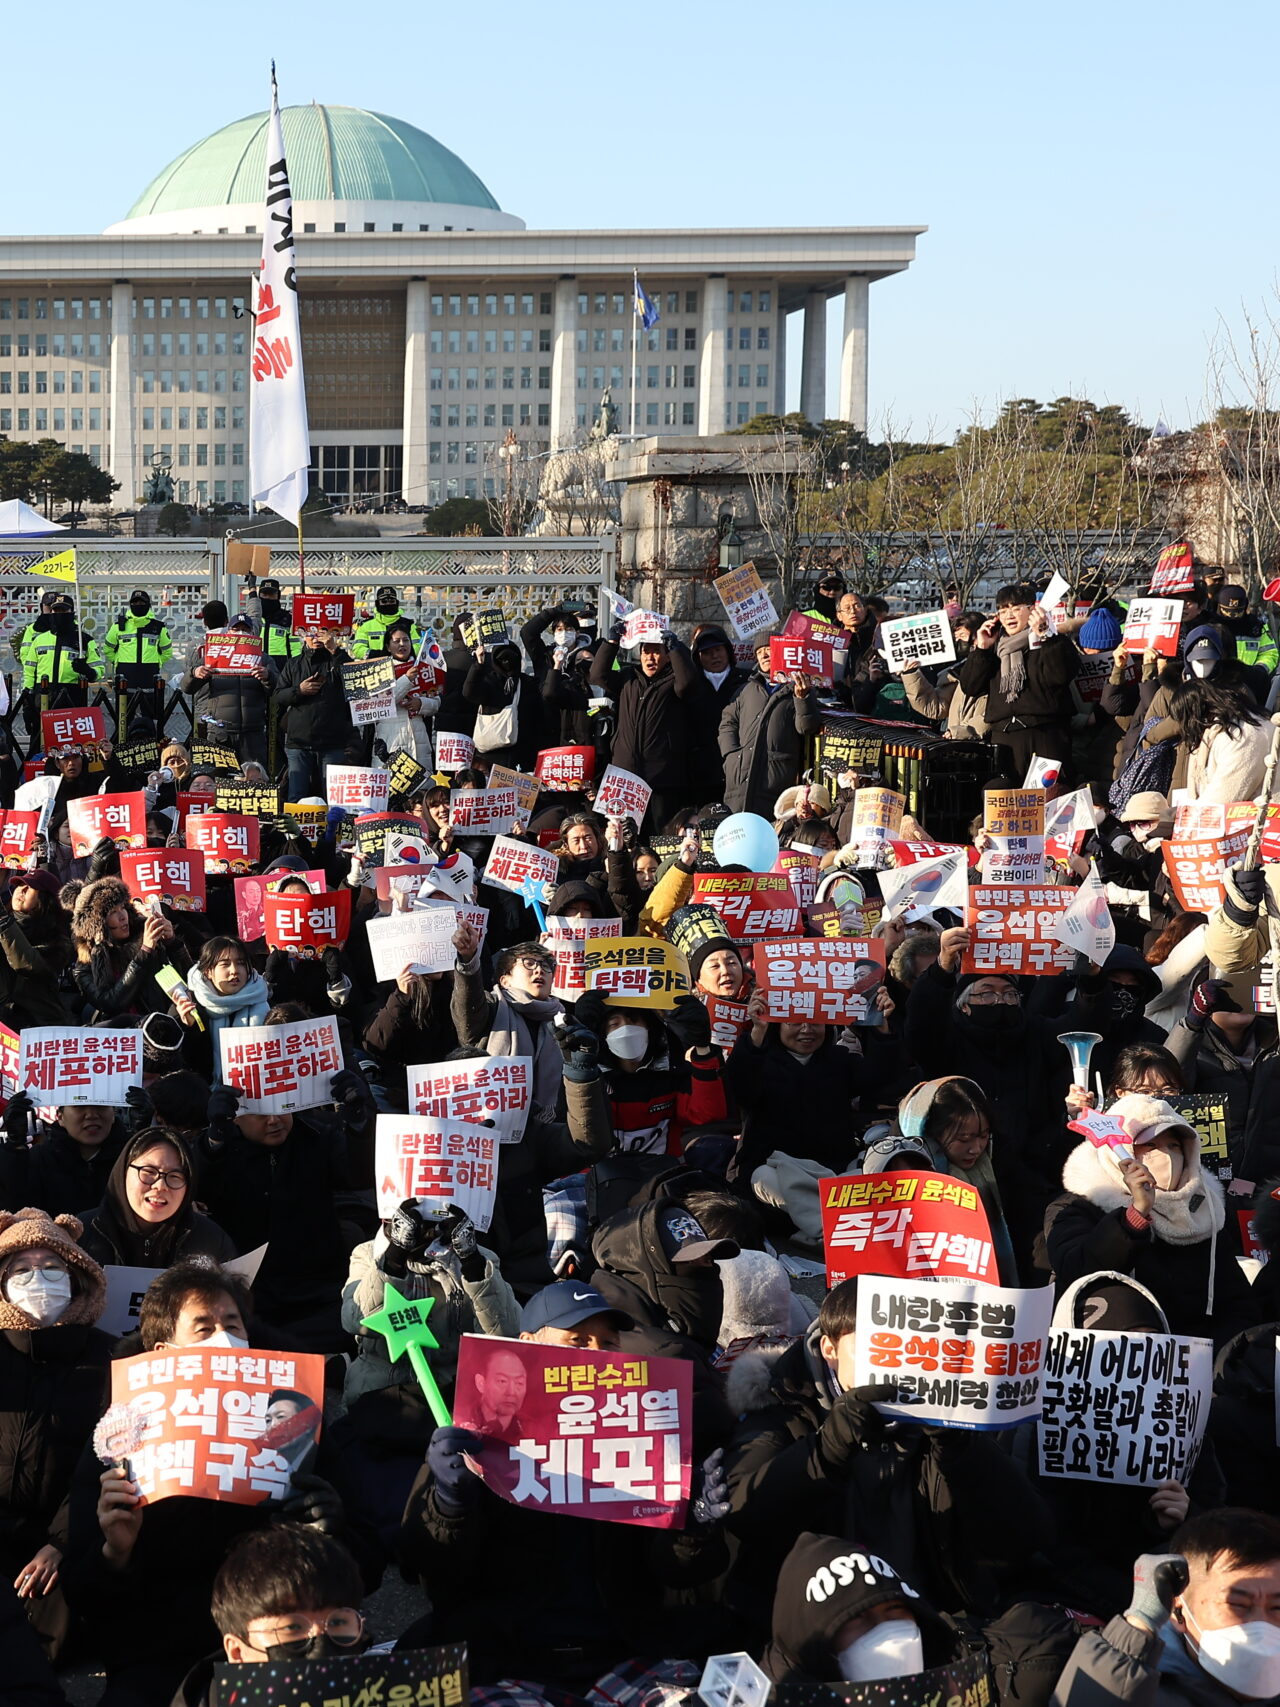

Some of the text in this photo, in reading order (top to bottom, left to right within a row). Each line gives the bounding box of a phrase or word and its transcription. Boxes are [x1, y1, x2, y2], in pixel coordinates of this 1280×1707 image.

[304, 603, 343, 625] 탄핵
[888, 624, 942, 647] 윤석열을
[206, 645, 236, 659] 즉각
[231, 654, 262, 667] 탄핵!
[783, 646, 823, 673] 탄핵
[890, 639, 946, 663] 탄핵하라
[53, 717, 96, 743] 탄핵
[542, 753, 585, 768] 윤석열을
[542, 765, 585, 780] 탄핵하라
[359, 772, 387, 785] 윤석열
[606, 774, 636, 790] 내란범
[328, 784, 388, 804] 체포하라
[453, 791, 515, 809] 내란범 윤석열
[80, 803, 131, 833] 탄핵
[452, 803, 517, 827] 체포하라
[196, 826, 248, 856] 탄핵
[1169, 843, 1215, 859] 반민주
[489, 858, 557, 884] 체포하라
[495, 846, 558, 872] 내란범 윤석열
[135, 859, 191, 893] 탄핵
[698, 876, 788, 893] 내란수괴 윤석열
[991, 869, 1037, 882] 공범이다!
[703, 896, 752, 919] 즉각
[974, 887, 1075, 907] 반민주 반헌법
[1181, 882, 1219, 910] 탄핵
[275, 905, 337, 940] 탄핵
[588, 924, 620, 939] 윤석열
[743, 907, 799, 935] 탄핵!
[974, 909, 1064, 940] 윤석열
[585, 946, 666, 971] 윤석열을
[764, 942, 869, 959] 반민주 반헌법
[973, 942, 1076, 971] 탄핵 구속
[595, 966, 690, 994] 탄핵하라
[768, 960, 857, 989] 윤석열
[767, 990, 868, 1022] 탄핵 구속
[26, 1035, 137, 1057] 내란범 윤석열
[227, 1024, 334, 1065] 내란범 윤석열
[23, 1053, 139, 1091] 체포하라
[228, 1047, 340, 1100] 체포하라
[415, 1063, 527, 1098] 내란범 윤석열
[415, 1086, 528, 1124] 체포하라
[1181, 1104, 1225, 1125] 윤석열
[1088, 1117, 1116, 1133] 탄핵
[447, 1132, 495, 1160] 윤석열
[381, 1157, 495, 1198] 체포하라
[827, 1178, 979, 1211] 내란수괴 윤석열
[828, 1207, 914, 1252] 즉각
[905, 1232, 993, 1277] 탄핵!
[388, 1305, 423, 1332] 탄핵
[871, 1292, 1017, 1339] 내란주범
[868, 1330, 1041, 1377] 윤석열 퇴진
[1045, 1332, 1192, 1384] 세계 어디에도
[127, 1354, 296, 1391] 반민주 반헌법
[542, 1360, 649, 1394] 반란수괴
[869, 1373, 989, 1411] 내란세력
[128, 1387, 270, 1440] 윤석열
[556, 1388, 681, 1436] 윤석열
[1042, 1380, 1202, 1439] 군홧발과 총칼이
[128, 1439, 291, 1501] 탄핵 구속
[508, 1433, 682, 1504] 체포!
[1042, 1435, 1185, 1484] 필요한 나라는
[386, 1668, 464, 1707] 윤석열
